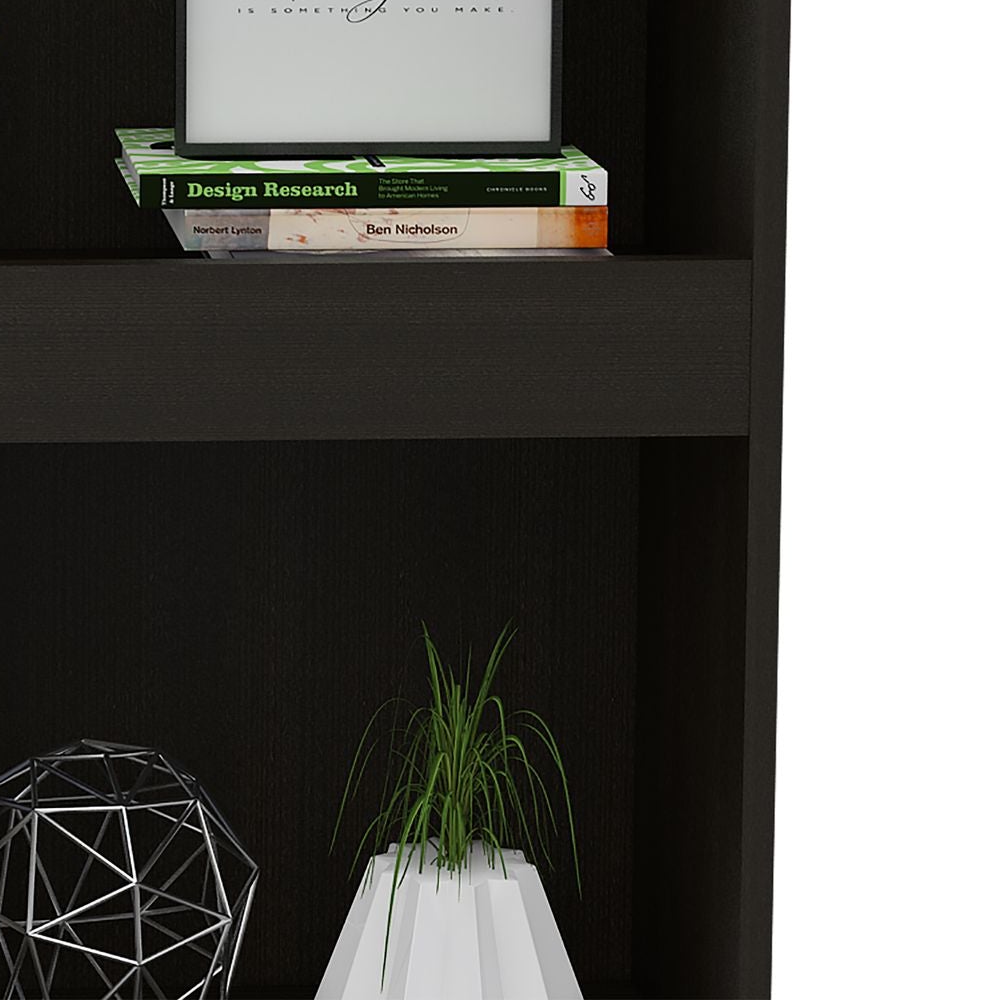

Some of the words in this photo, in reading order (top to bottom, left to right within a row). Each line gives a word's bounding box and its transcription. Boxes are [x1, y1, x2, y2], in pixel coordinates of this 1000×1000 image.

[186, 181, 258, 202] Design
[262, 181, 359, 198] Research
[193, 225, 228, 236] Norbert
[231, 225, 262, 239] Lynton
[366, 223, 394, 236] Ben
[397, 223, 458, 236] Nicholson
